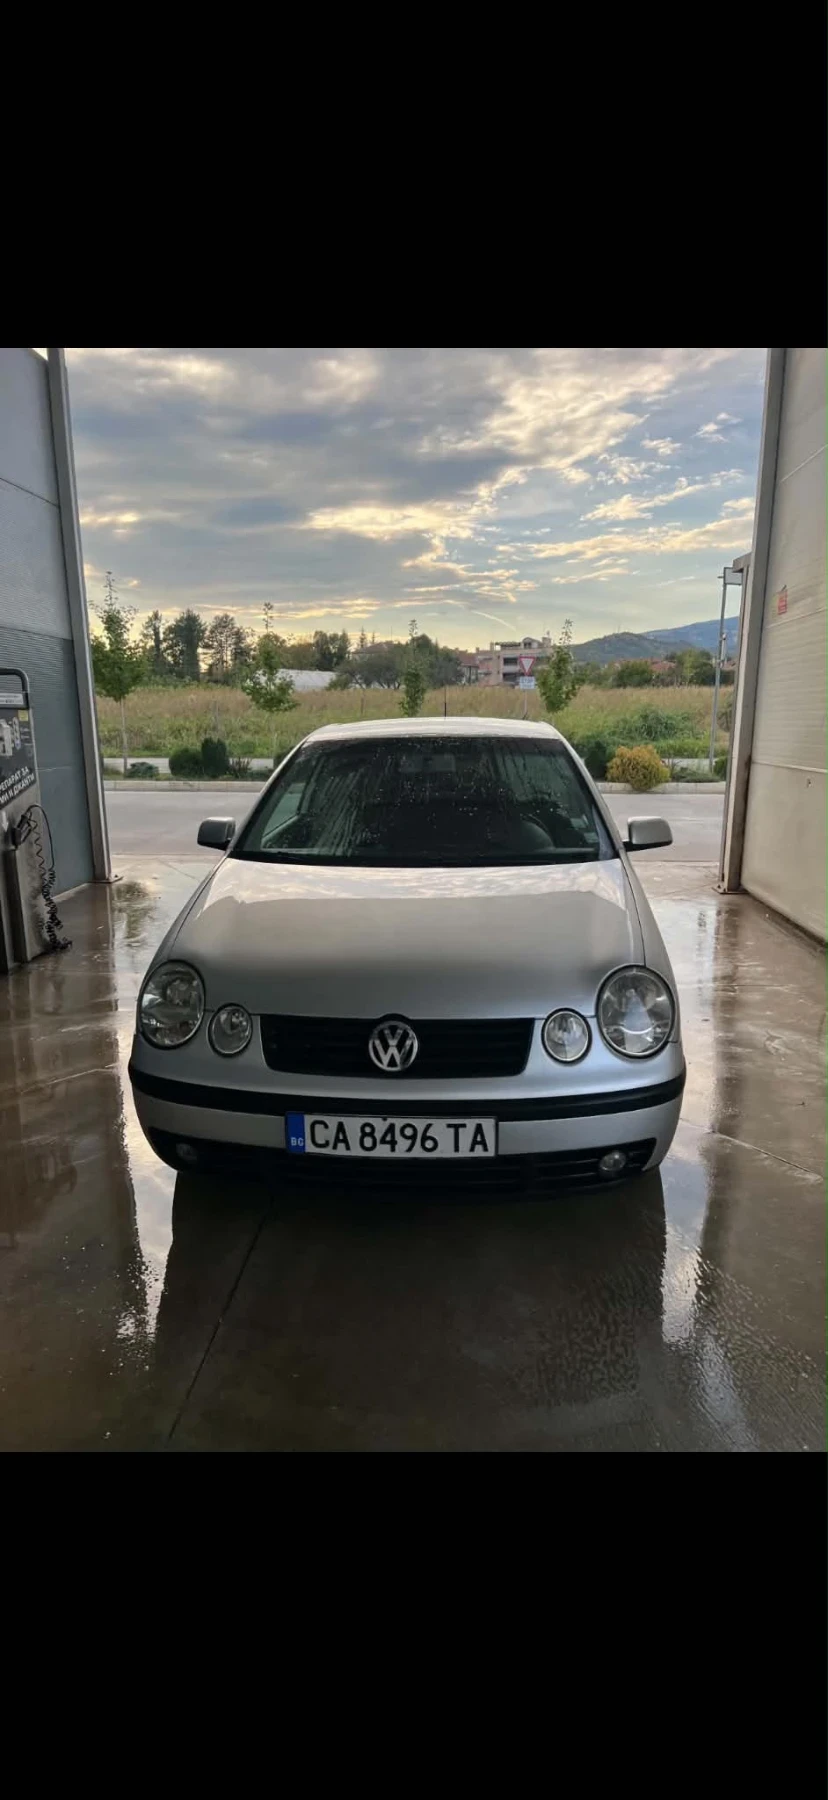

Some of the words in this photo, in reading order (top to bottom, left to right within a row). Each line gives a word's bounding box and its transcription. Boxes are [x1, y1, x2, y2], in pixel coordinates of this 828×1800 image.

[290, 1136, 304, 1147] BG
[310, 1119, 351, 1150] CA
[359, 1121, 438, 1153] 8496
[446, 1122, 489, 1152] TA
